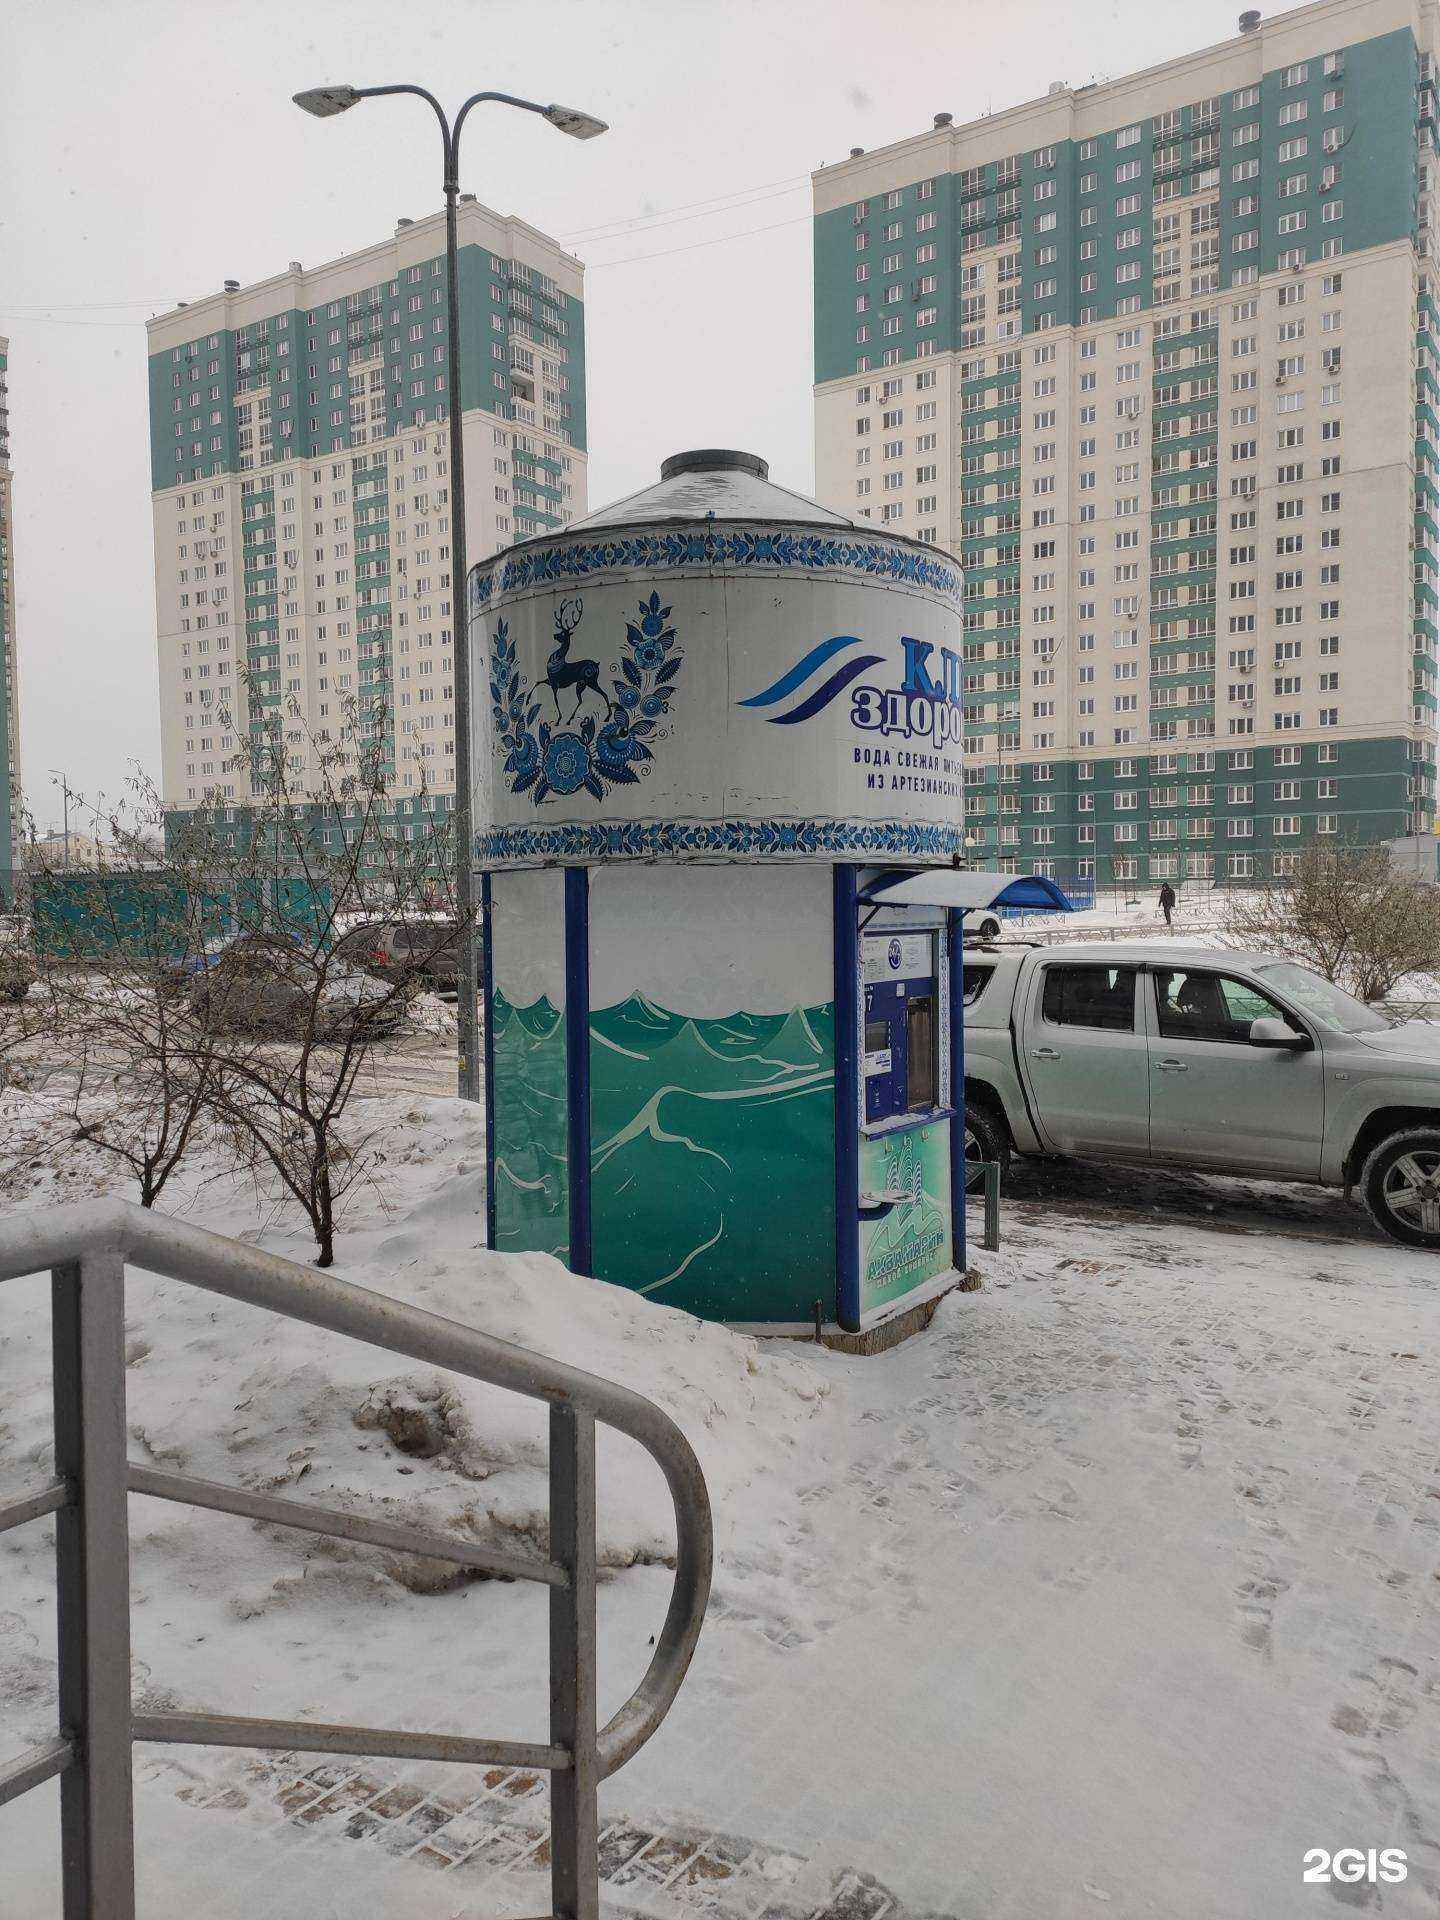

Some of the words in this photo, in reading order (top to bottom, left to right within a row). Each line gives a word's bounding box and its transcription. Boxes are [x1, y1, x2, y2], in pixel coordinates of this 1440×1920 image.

[854, 747, 891, 766] ВОДА
[897, 752, 939, 771] СВЕЖАЯ
[867, 773, 884, 789] ИЗ
